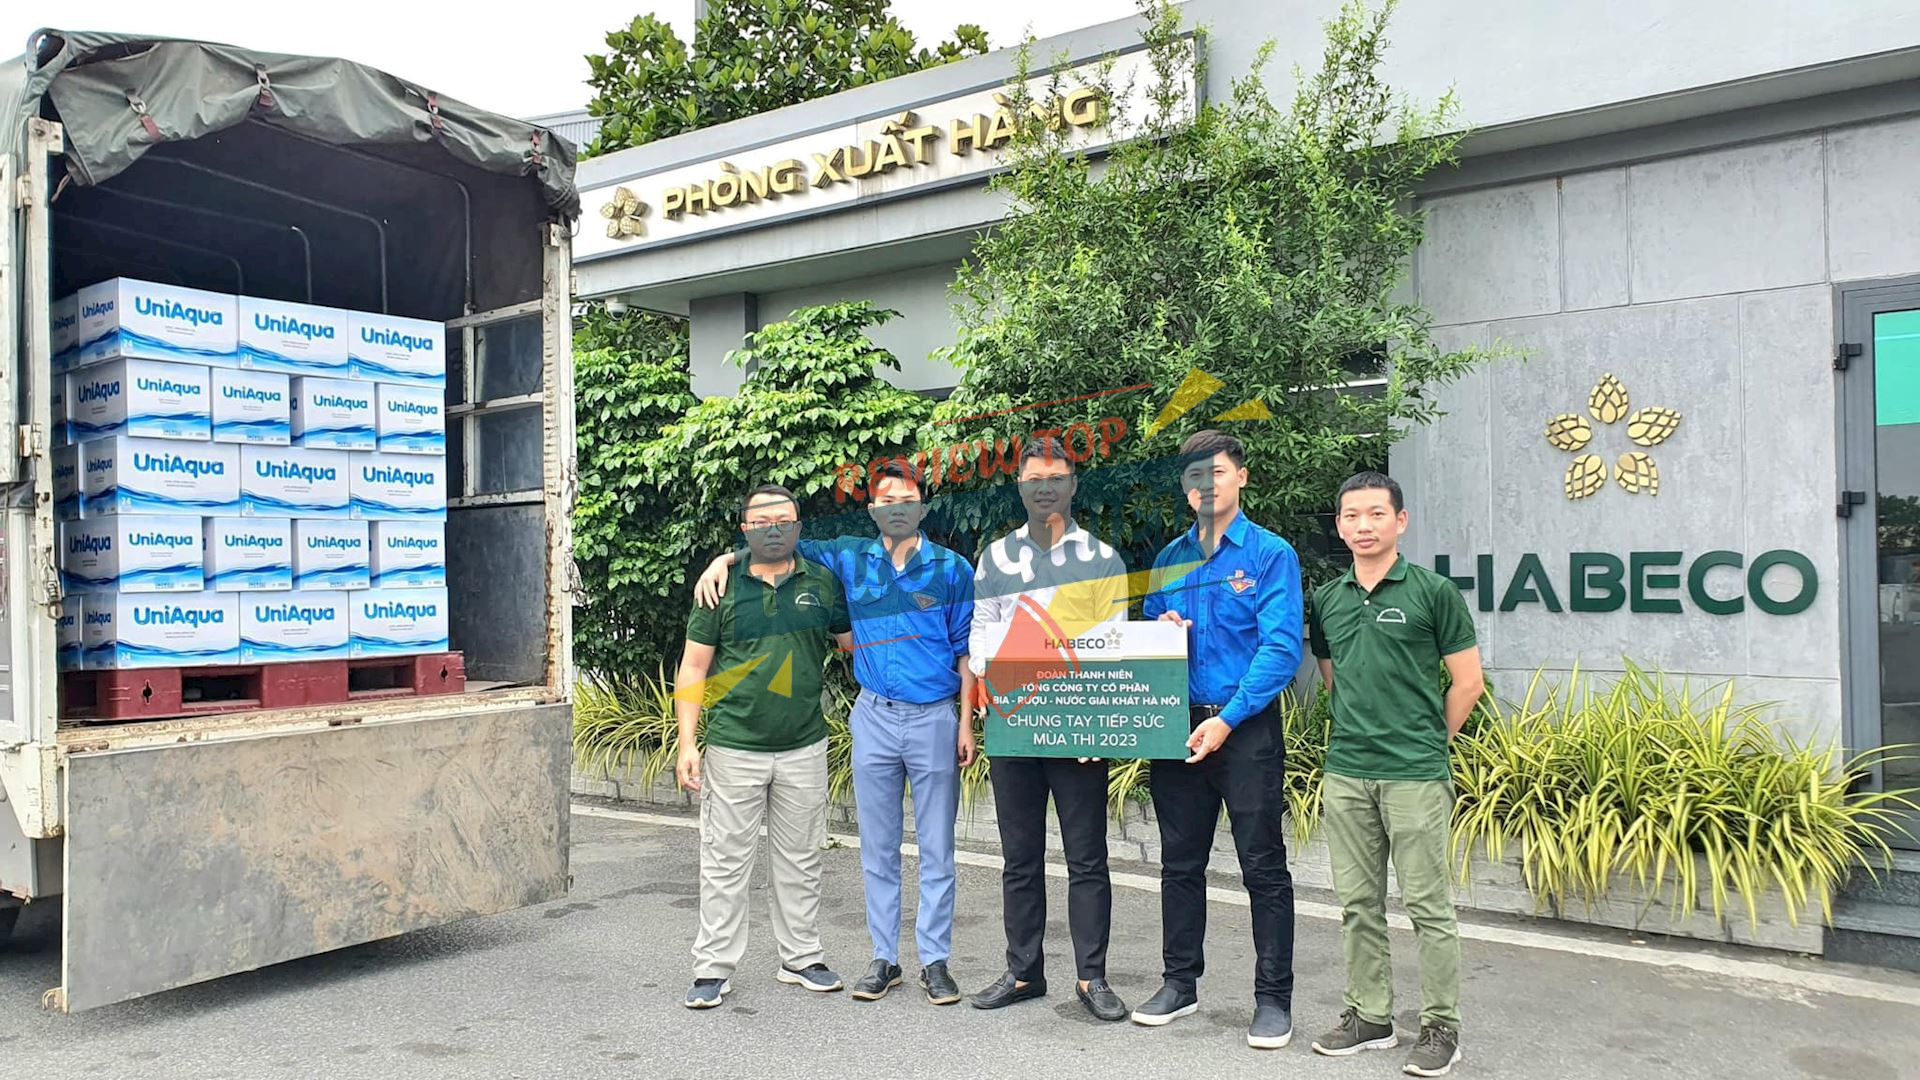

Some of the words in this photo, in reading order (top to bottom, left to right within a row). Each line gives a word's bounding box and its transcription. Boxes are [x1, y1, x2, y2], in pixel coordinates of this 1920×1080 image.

[661, 161, 803, 220] PHÒNG
[810, 110, 940, 189] XUẤT
[951, 87, 1101, 156] HÀNG
[82, 300, 114, 318] UniAqua
[135, 296, 222, 326] UniAqua
[255, 313, 335, 340] UniAqua
[361, 327, 433, 352] UniAqua
[78, 380, 121, 403] UniAqua
[137, 378, 201, 396] UniAqua
[223, 386, 281, 402] UniAqua
[313, 395, 369, 410] UniAqua
[388, 401, 438, 417] UniAqua
[134, 453, 224, 478] UniAqua
[256, 460, 336, 483] UniAqua
[363, 466, 434, 487] UniAqua
[69, 533, 111, 555] UniAqua
[129, 533, 193, 548] UniAqua
[225, 534, 283, 549] UniAqua
[307, 536, 361, 550] UniAqua
[387, 536, 438, 550] UniAqua
[1435, 550, 1819, 615] HABECO
[134, 606, 224, 628] UniAqua
[255, 605, 335, 625] UniAqua
[364, 602, 436, 621] UniAqua
[1044, 638, 1106, 650] HABECO
[1036, 669, 1067, 680] ĐOÀN
[1069, 670, 1106, 680] THANH
[1108, 669, 1133, 680] NIÊN
[1052, 682, 1083, 693] CÔNG
[1085, 683, 1099, 693] TY
[1119, 682, 1150, 693] PHẦN
[992, 695, 1010, 705] BIA
[1017, 694, 1047, 707] RƯỢU
[1055, 694, 1087, 706] NƯỚC
[1112, 694, 1140, 706] KHÁT
[1142, 695, 1158, 706] HÀ
[1161, 695, 1181, 707] NỘI
[1007, 714, 1062, 728] CHUNG
[1066, 714, 1094, 728] TAY
[1097, 712, 1129, 729] TIẾP
[1132, 712, 1166, 729] SỨC
[1033, 730, 1068, 746] MÙA
[1071, 732, 1096, 746] THI
[1099, 733, 1138, 747] 2023
